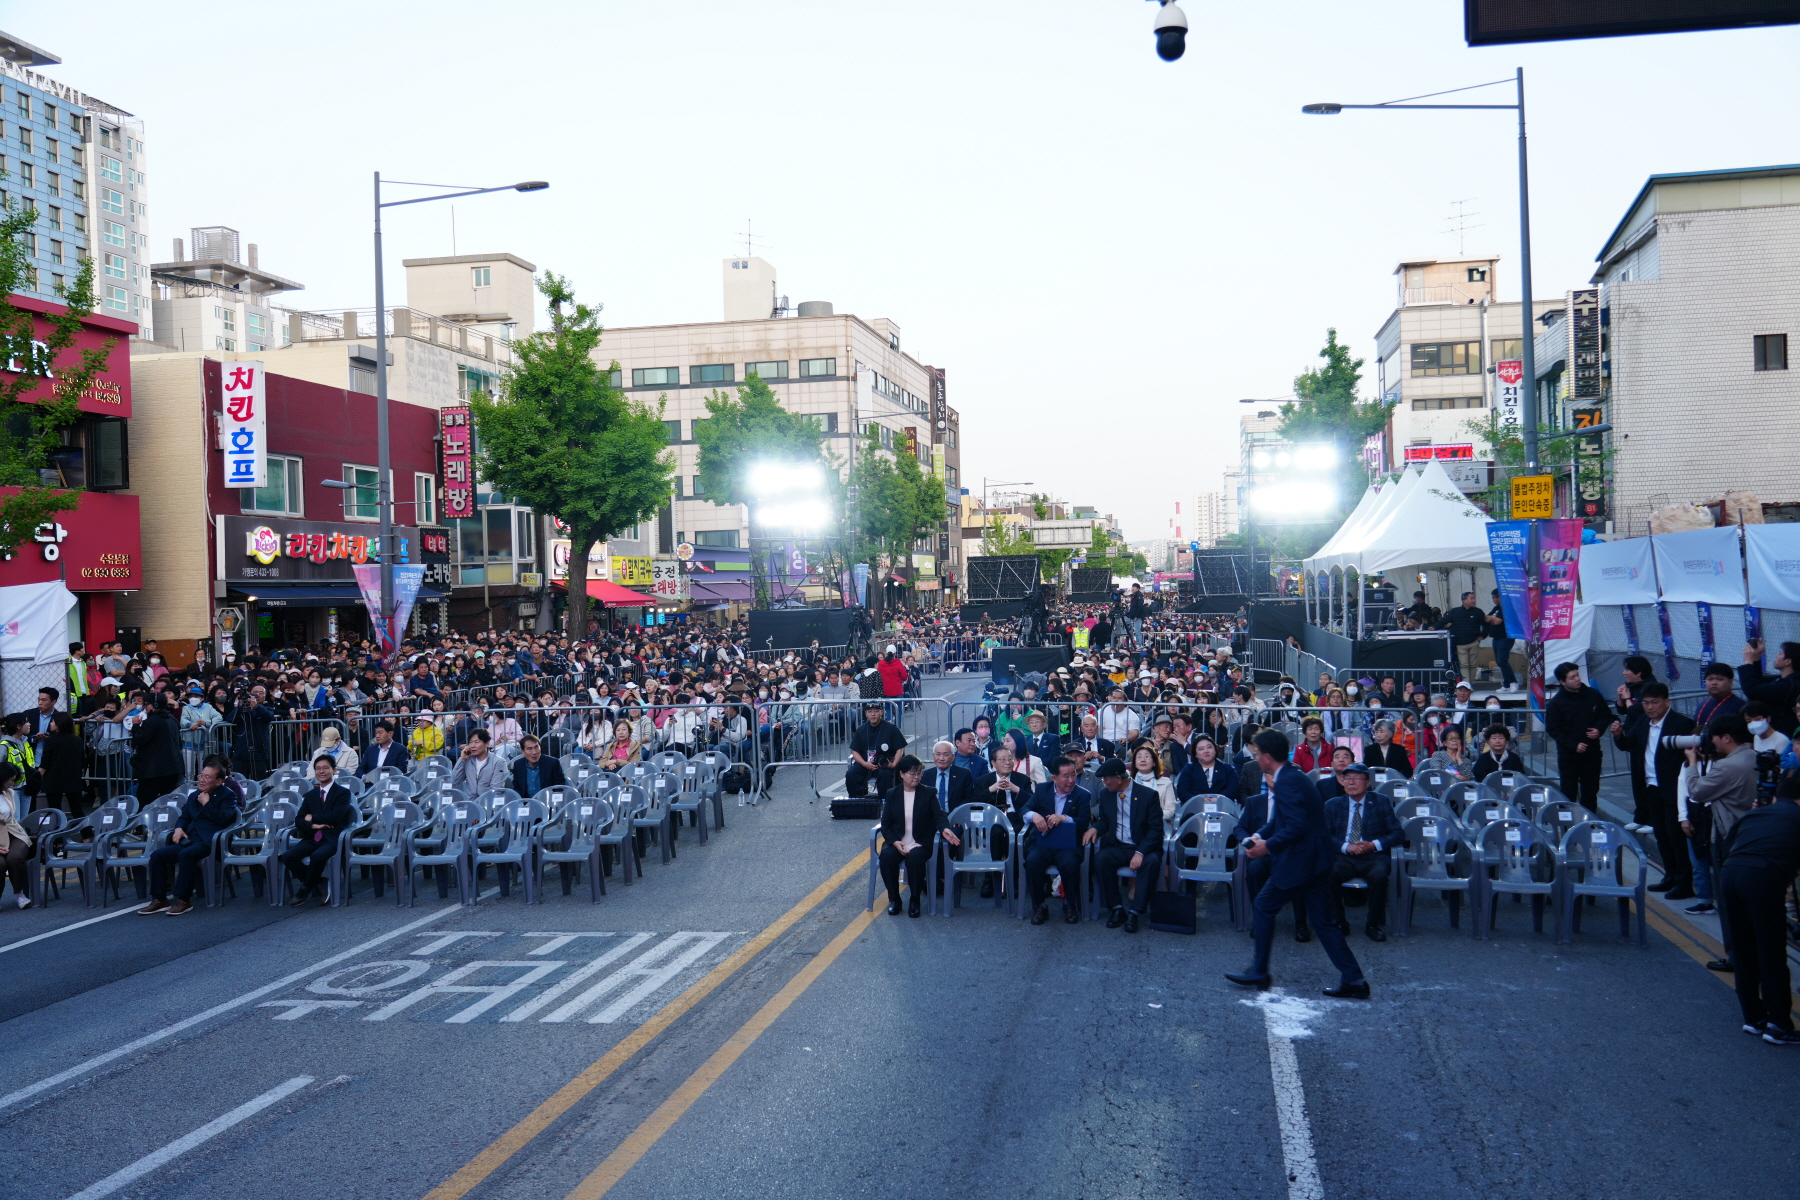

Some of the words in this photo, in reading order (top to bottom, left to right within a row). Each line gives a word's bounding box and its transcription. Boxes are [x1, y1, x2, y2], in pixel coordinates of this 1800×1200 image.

[1574, 293, 1597, 316] 수
[225, 366, 255, 483] 치킨호프
[446, 433, 468, 512] 노래방
[1514, 482, 1551, 497] 불법주정차
[1514, 499, 1550, 513] 무인단속중
[82, 567, 93, 578] 02
[628, 559, 653, 580] 멸치국수
[652, 566, 676, 579] 궁전
